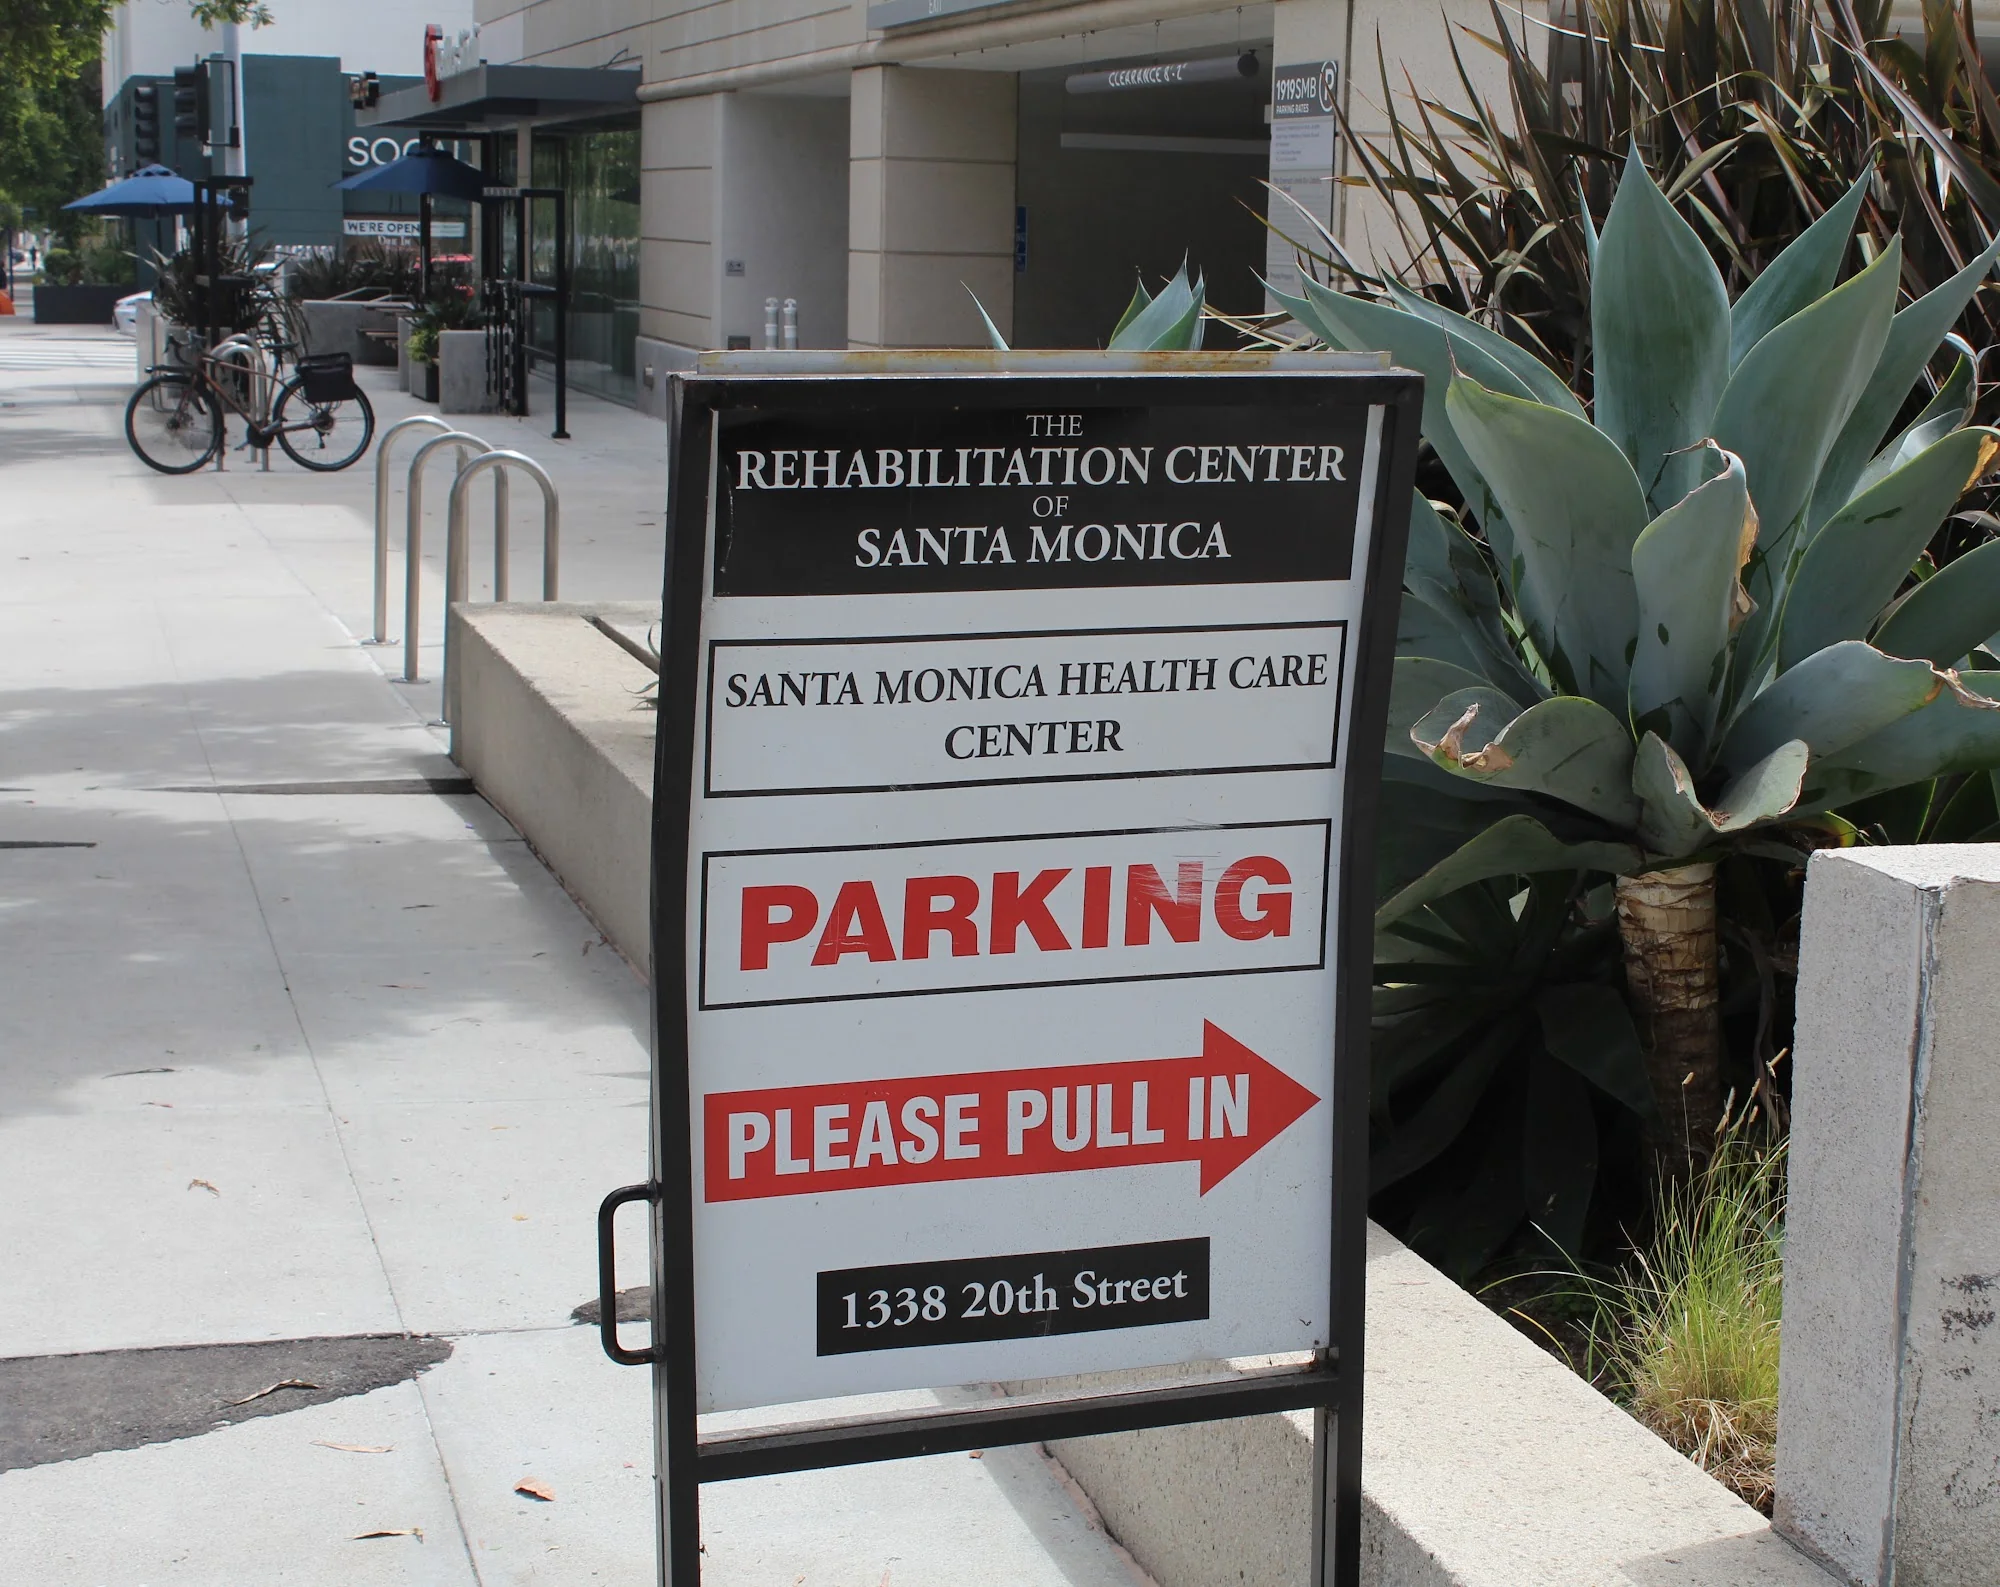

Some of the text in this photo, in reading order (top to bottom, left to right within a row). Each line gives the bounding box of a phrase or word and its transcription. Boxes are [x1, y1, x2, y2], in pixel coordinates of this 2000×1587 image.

[1108, 66, 1162, 87] CLEARANCE
[1275, 76, 1317, 101] 1919SMB
[1276, 103, 1310, 114] PARKING RATES
[347, 221, 385, 233] WE'RE
[386, 222, 421, 234] OPEN
[1026, 413, 1083, 437] THE
[736, 445, 1347, 490] REHABILITATION CENTER
[1032, 495, 1069, 518] OF
[855, 521, 1232, 568] SANTA MONICA
[725, 653, 1328, 708] SANTA MONICA HEALTH CARE
[944, 719, 1124, 760] CENTER
[740, 855, 1293, 972] PARKING
[728, 1073, 1250, 1180] PLEASE PULL IN
[841, 1269, 1189, 1330] 1338 20th Street
